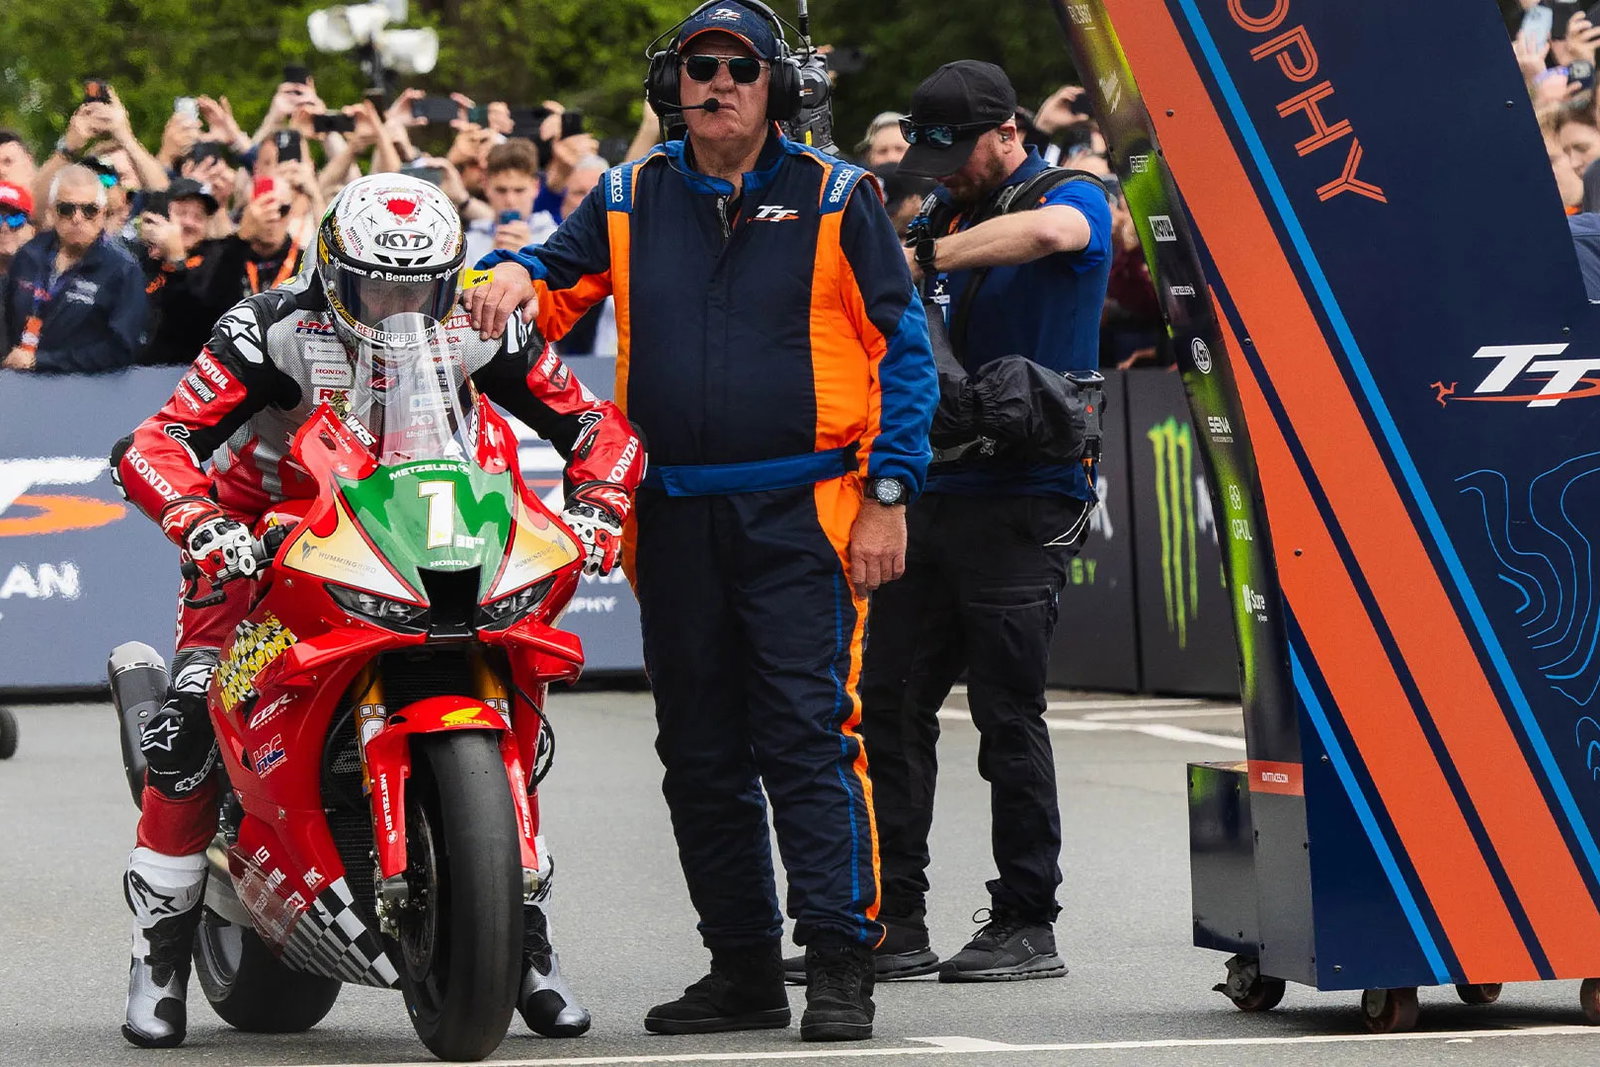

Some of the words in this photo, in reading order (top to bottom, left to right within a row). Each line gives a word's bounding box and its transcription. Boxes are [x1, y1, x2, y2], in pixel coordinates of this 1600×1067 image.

[610, 168, 624, 203] sparco
[828, 169, 855, 203] sparco
[381, 233, 427, 248] KYT
[386, 272, 433, 282] Bennetts
[196, 351, 229, 391] MOTUL
[315, 368, 347, 376] HONDA
[1472, 343, 1600, 407] TT
[1208, 416, 1232, 433] SENA
[126, 446, 183, 501] HONDA
[389, 463, 458, 480] METZELER
[418, 480, 456, 550] 1
[430, 560, 470, 568] HONDA
[379, 773, 393, 831] METZELER
[302, 866, 323, 887] RK
